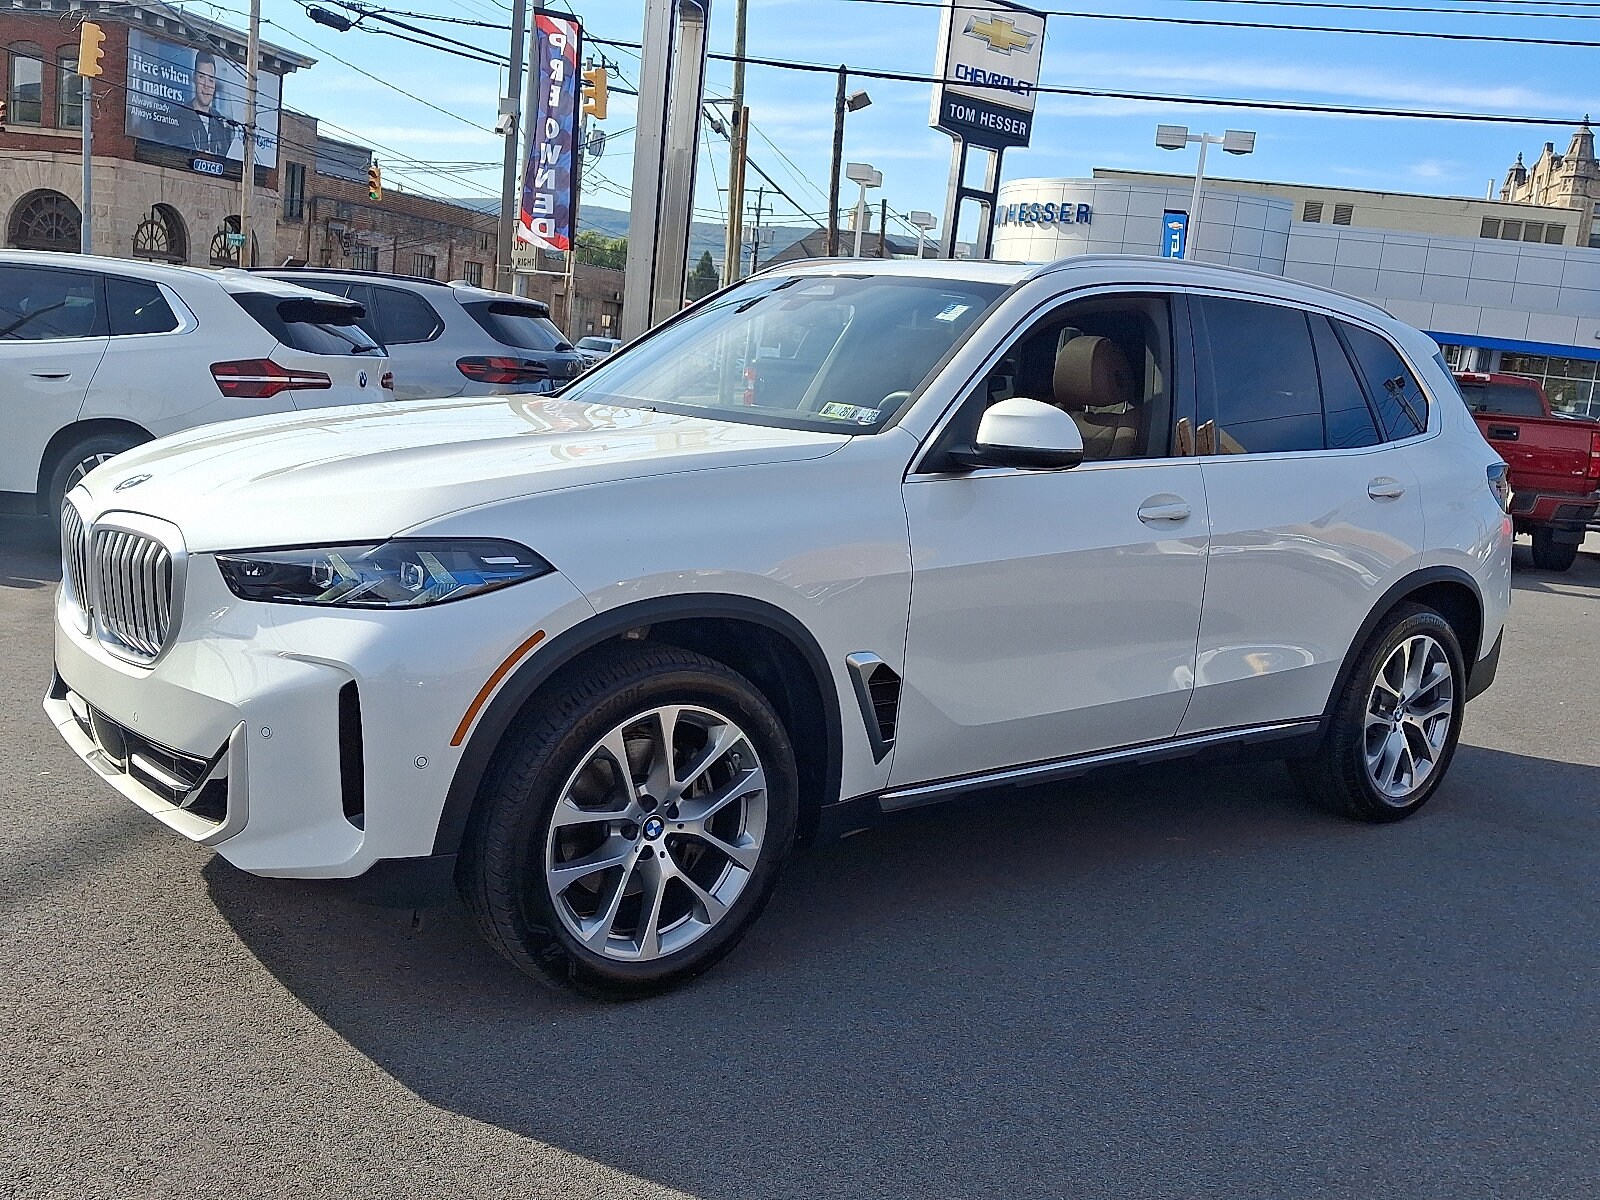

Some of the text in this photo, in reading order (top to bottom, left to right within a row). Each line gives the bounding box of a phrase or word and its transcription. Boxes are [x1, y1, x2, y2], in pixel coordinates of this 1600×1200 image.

[132, 54, 190, 86] Here when
[132, 73, 140, 90] it
[955, 63, 1033, 97] CHEVROLET
[131, 94, 153, 109] Always
[131, 106, 152, 121] Always
[949, 103, 1027, 136] TOM HESSER
[197, 159, 220, 173] JOYCE
[1008, 202, 1092, 224] HESSER
[513, 240, 528, 252] UST
[517, 257, 535, 268] RIGHT
